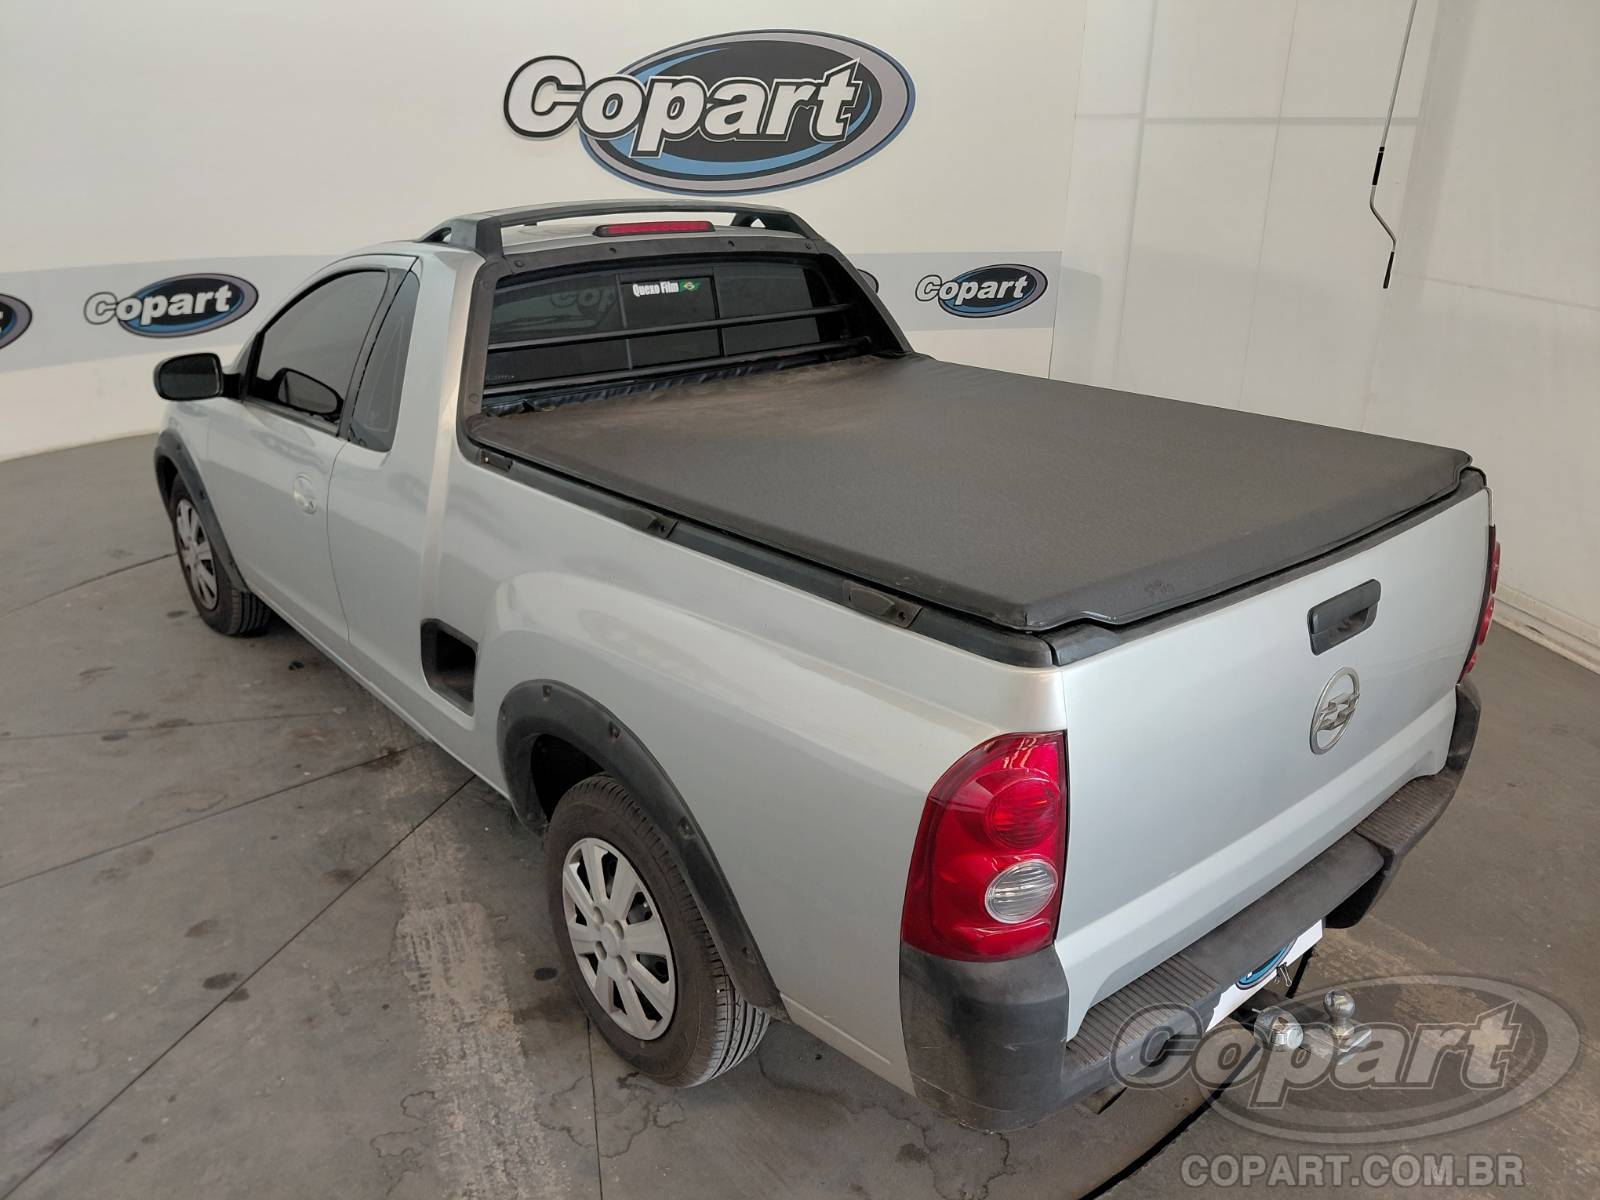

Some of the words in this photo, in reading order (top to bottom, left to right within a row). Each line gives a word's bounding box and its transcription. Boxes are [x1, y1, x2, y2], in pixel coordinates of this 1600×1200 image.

[504, 55, 862, 157] Copart
[84, 284, 232, 326] Copart
[660, 281, 679, 294] Film
[915, 273, 1028, 306] Copart
